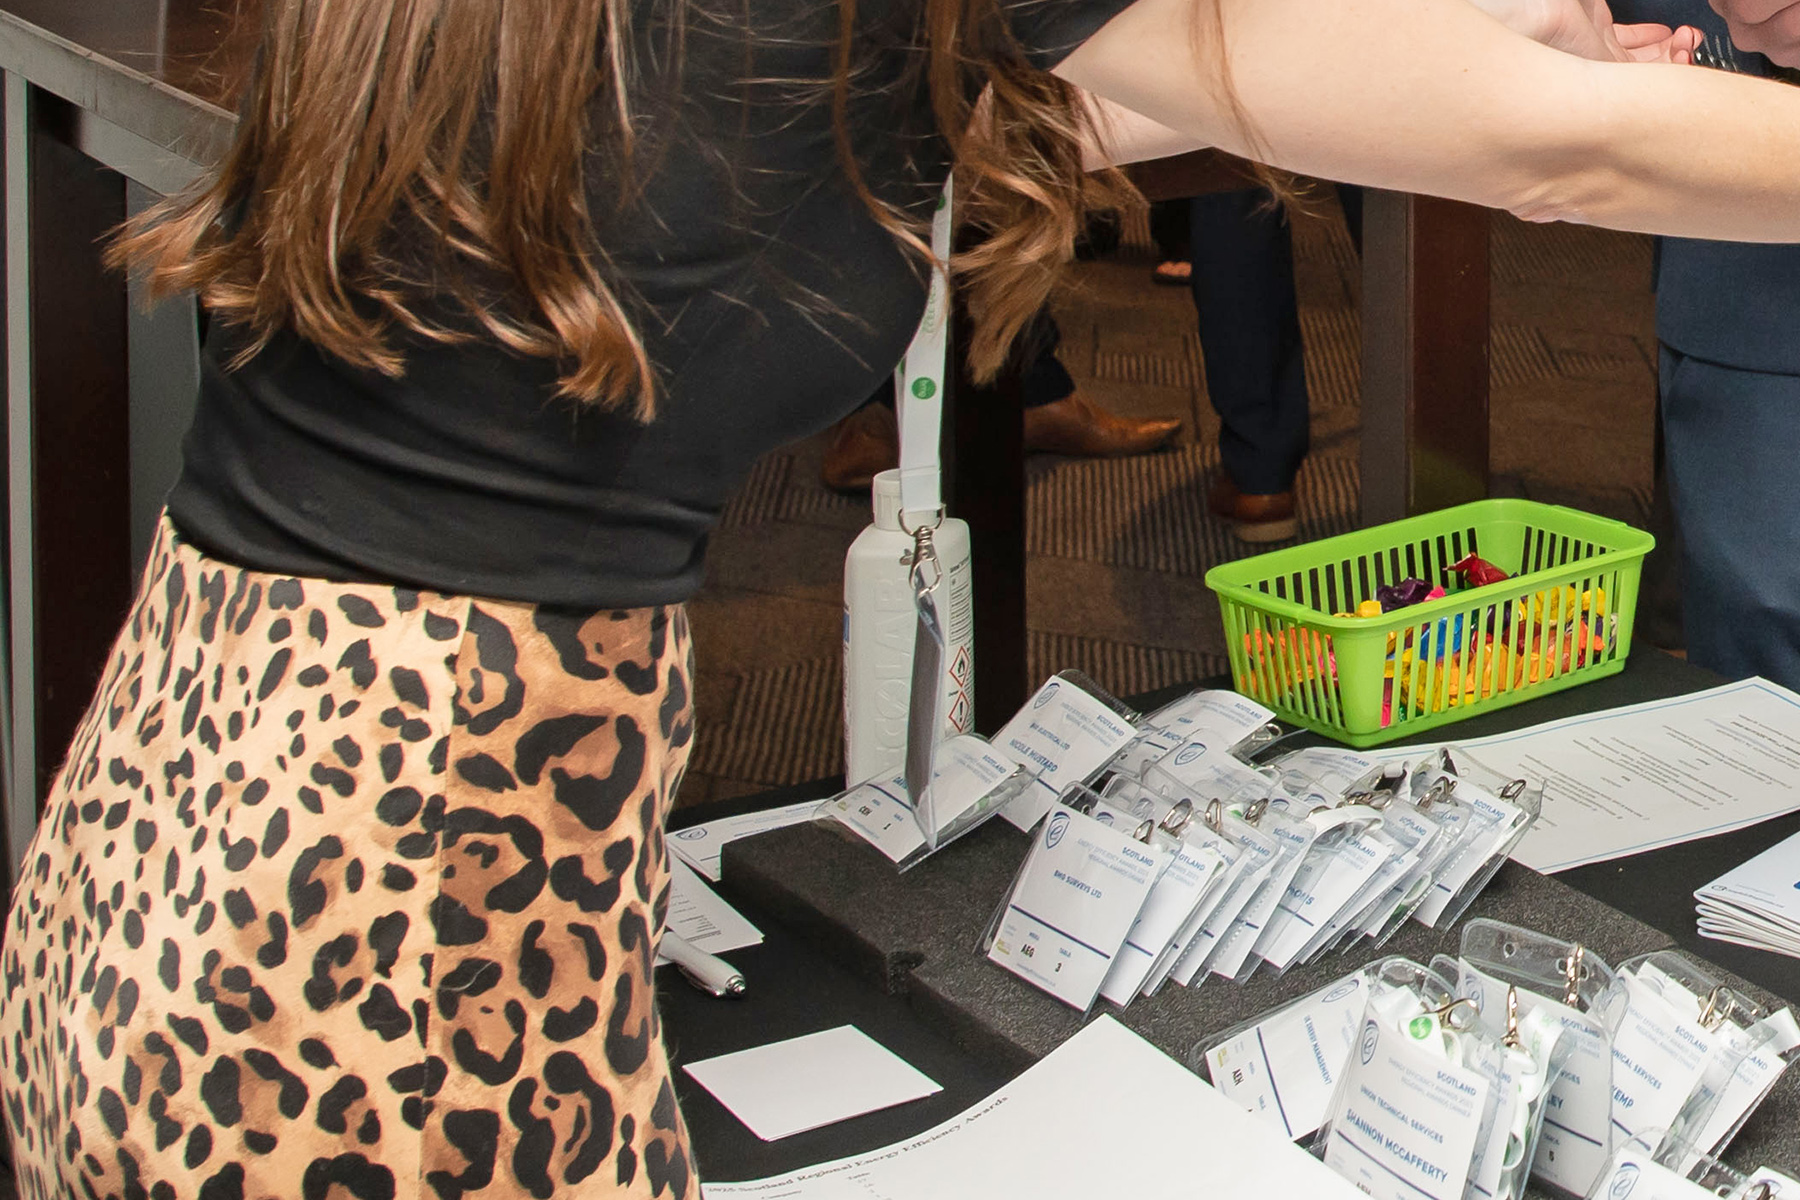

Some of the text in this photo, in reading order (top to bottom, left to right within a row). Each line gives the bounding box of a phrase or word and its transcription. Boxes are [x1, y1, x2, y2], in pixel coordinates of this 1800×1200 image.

[1473, 799, 1506, 820] SCOTLAND
[1121, 846, 1154, 867] SCOTLAND
[1674, 1024, 1709, 1054] SCOTLAND
[1437, 1070, 1477, 1097] SCOTLAND
[1633, 1062, 1663, 1091] SERVICES
[1377, 1097, 1409, 1125] TECHNICAL
[1410, 1118, 1444, 1145] SERVICES
[797, 1164, 853, 1182] Regional
[853, 1150, 900, 1168] Energy
[901, 1123, 962, 1153] Efficiency
[965, 1096, 1009, 1124] Awards
[1346, 1108, 1449, 1183] SHANNON MCCAFFERTY
